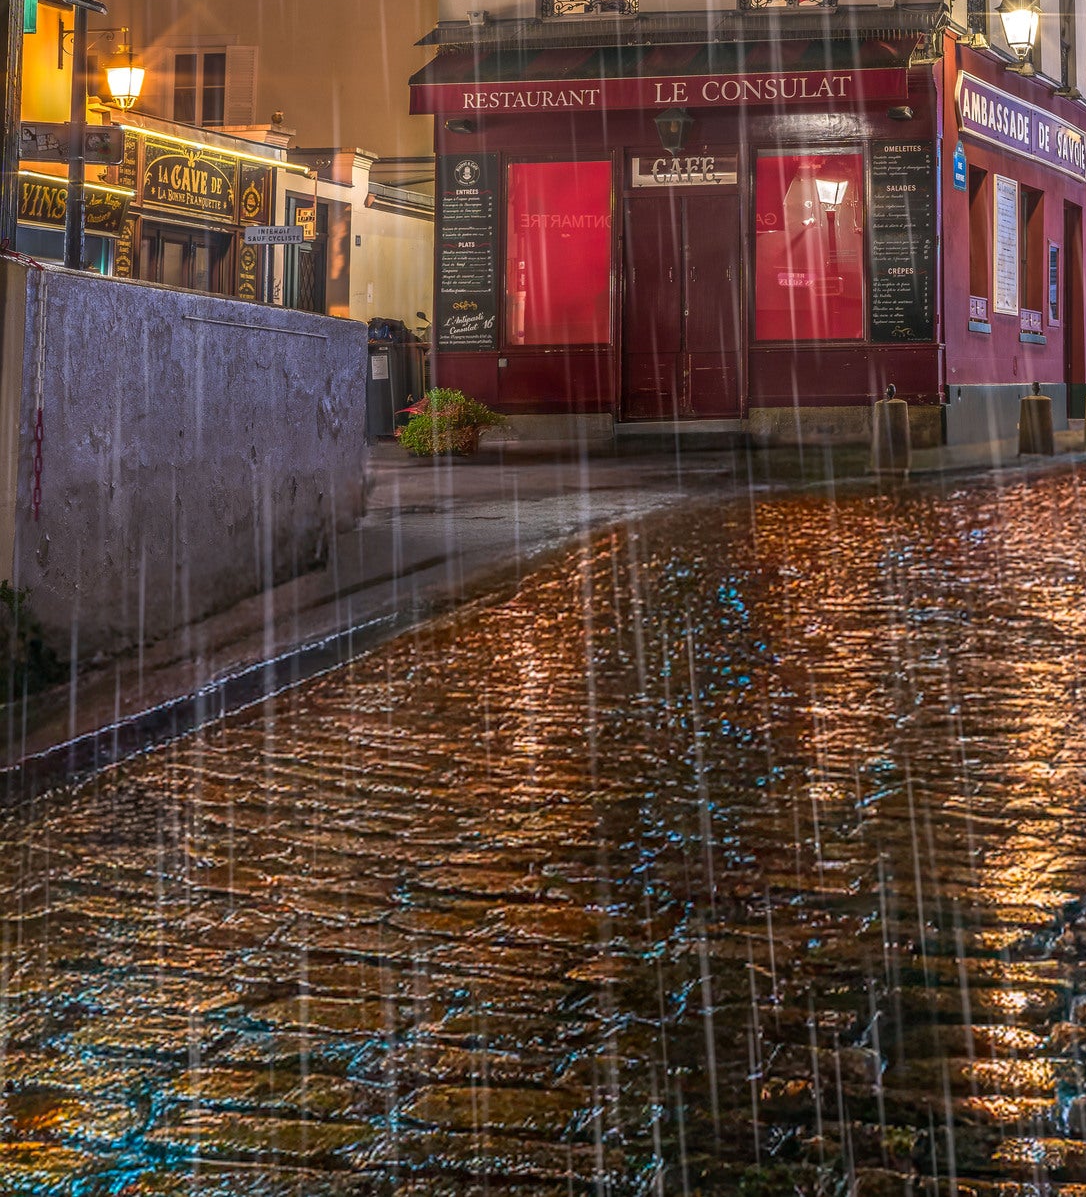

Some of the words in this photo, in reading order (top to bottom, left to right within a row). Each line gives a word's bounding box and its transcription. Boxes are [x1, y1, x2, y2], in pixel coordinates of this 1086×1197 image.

[462, 88, 600, 110] RESTAURANT
[654, 82, 689, 104] LE
[702, 75, 852, 103] CONSULAT
[963, 88, 1030, 144] AMBASSADE
[1038, 121, 1050, 151] DE
[1056, 129, 1086, 170] SAVOIE
[884, 145, 922, 153] OMELETTES
[158, 165, 169, 183] LA
[170, 164, 208, 195] CAVE
[211, 176, 223, 195] DE
[886, 184, 917, 192] SALADES
[21, 183, 69, 219] VINS
